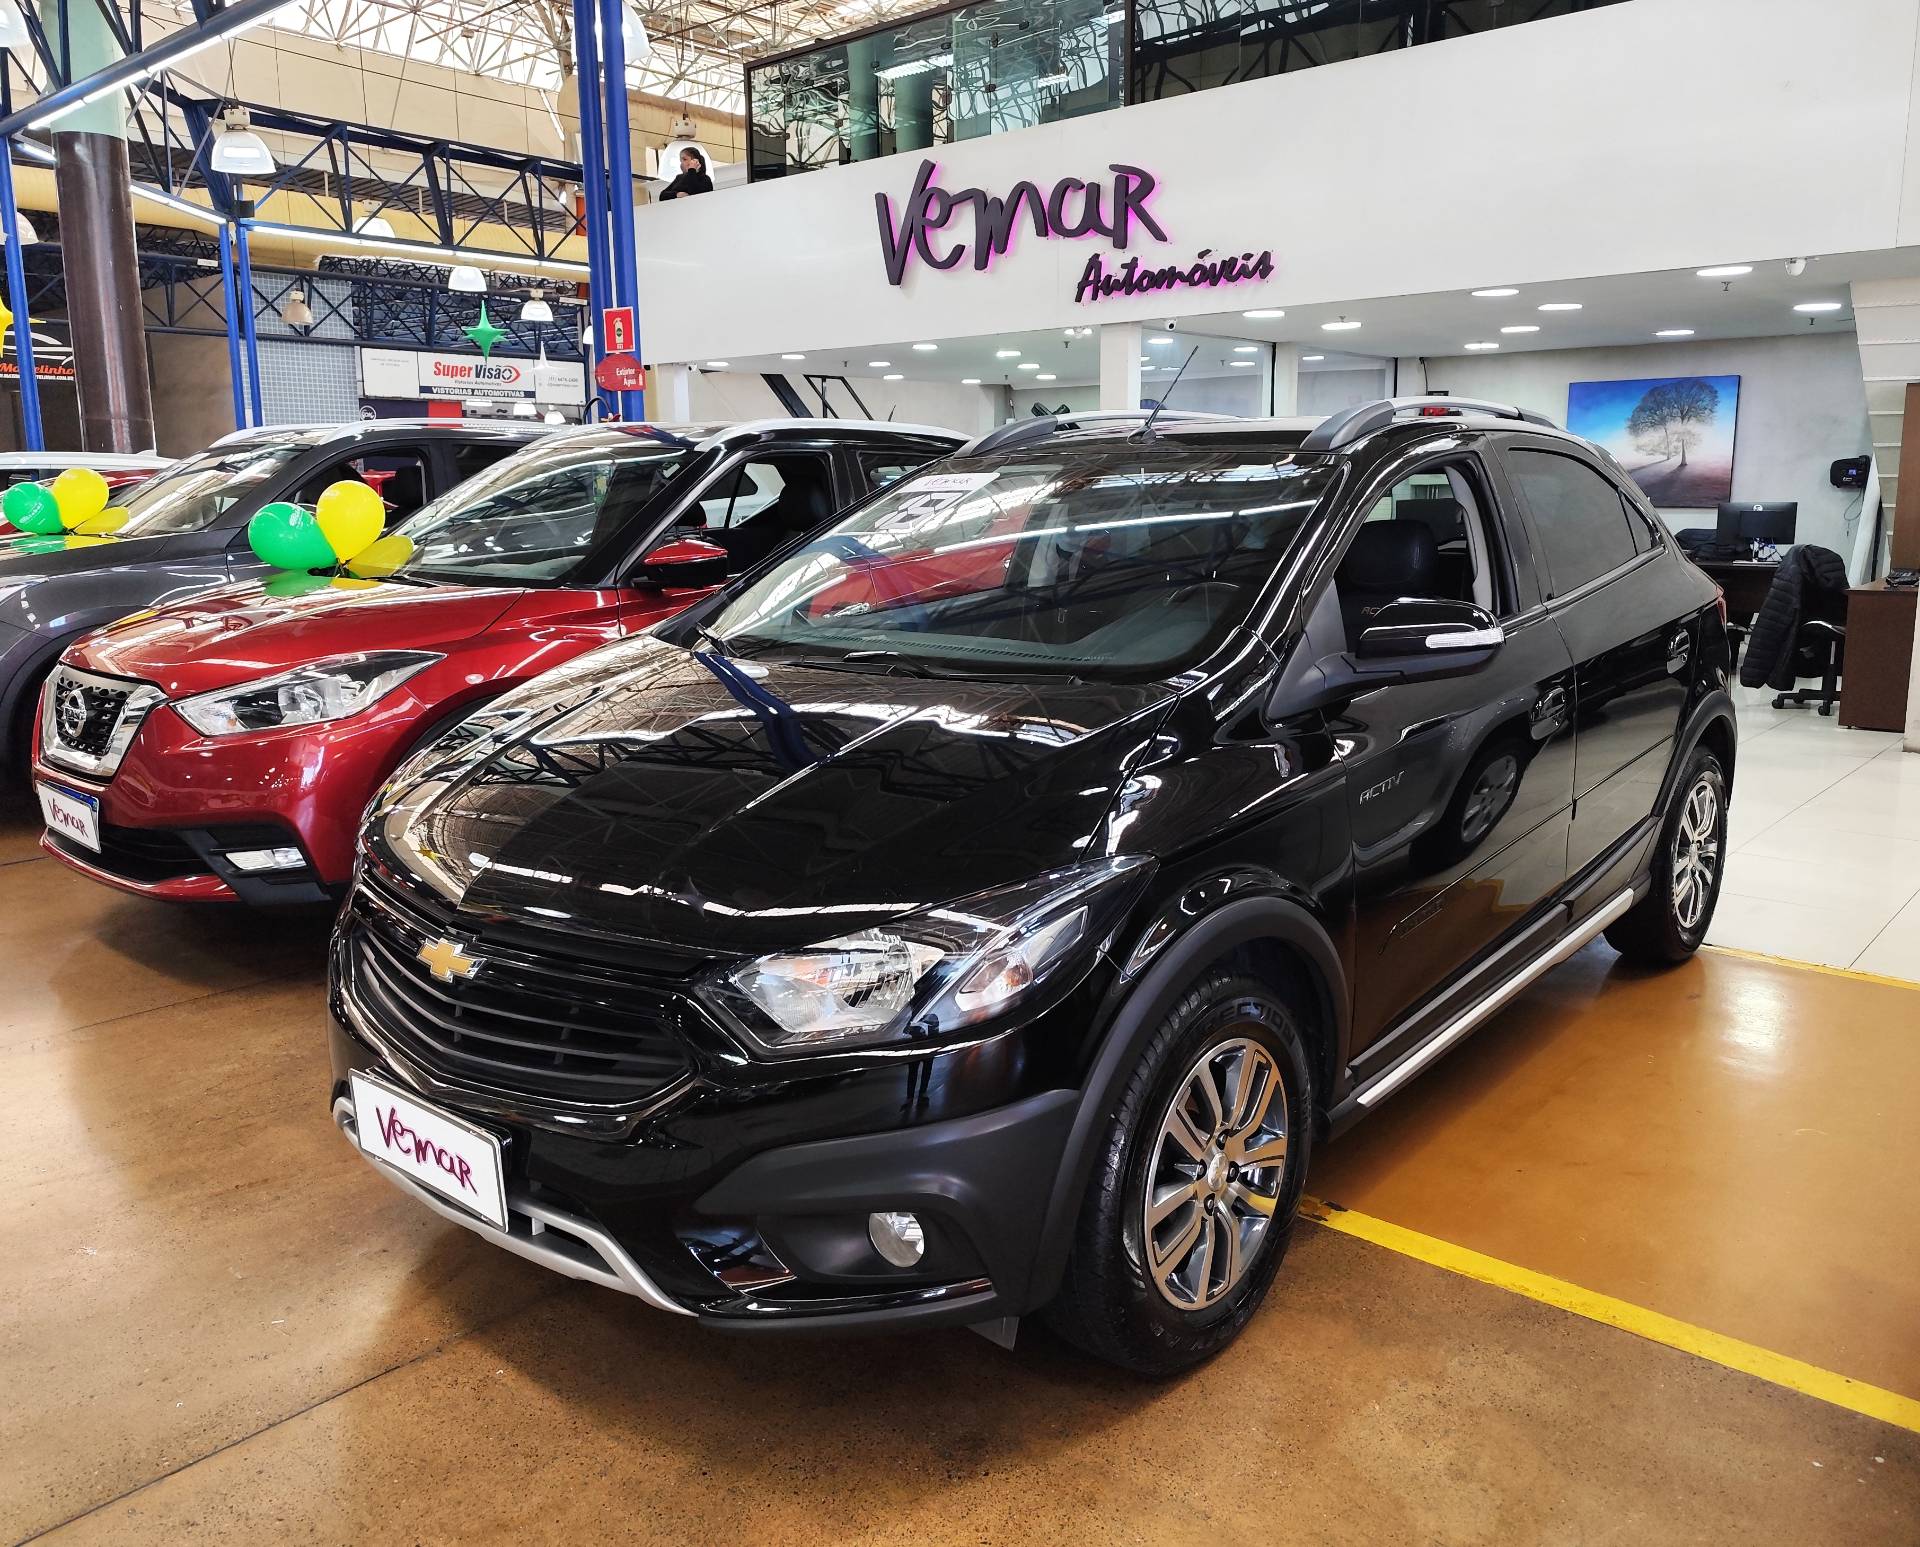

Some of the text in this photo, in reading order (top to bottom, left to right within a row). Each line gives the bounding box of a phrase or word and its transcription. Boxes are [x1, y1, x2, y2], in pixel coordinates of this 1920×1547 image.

[1074, 249, 1276, 303] Automóveis
[433, 361, 473, 378] Super
[432, 386, 525, 398] VISTORIAS AUTOMOTIVAS
[1359, 770, 1405, 805] ACTIV
